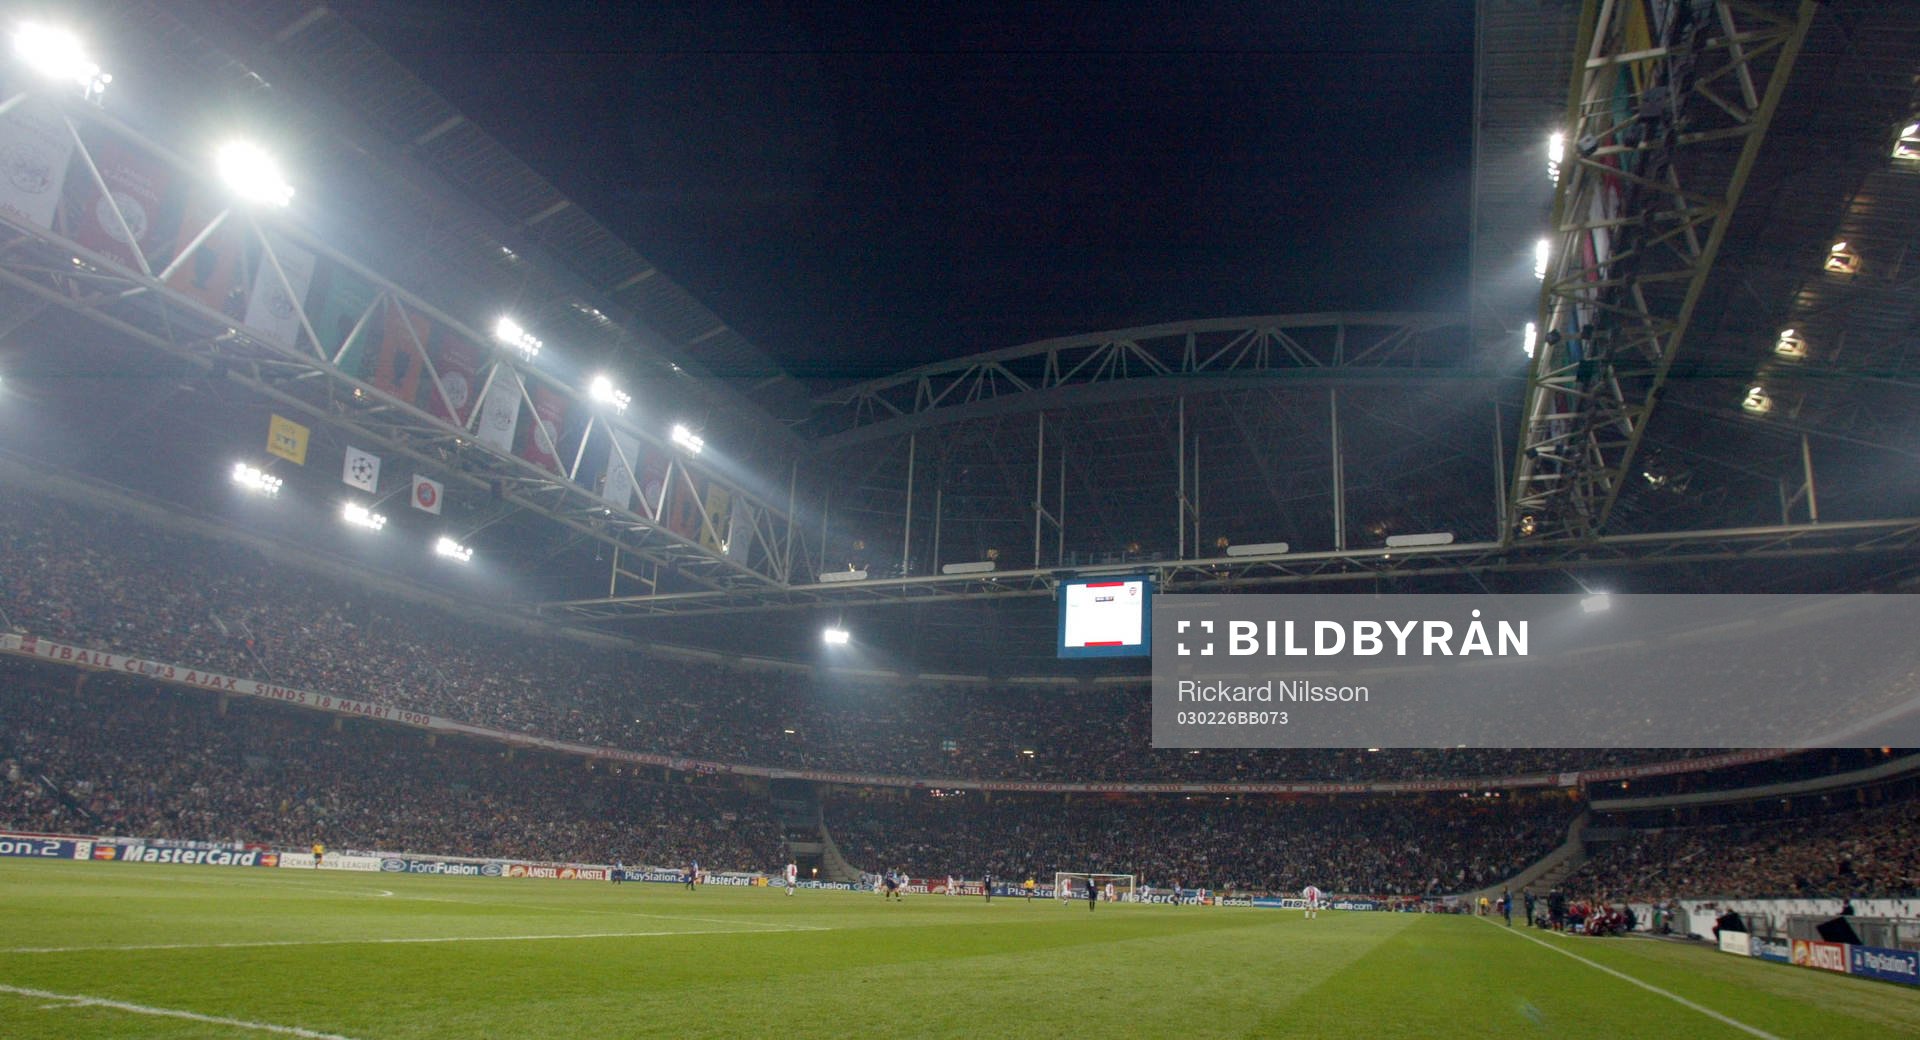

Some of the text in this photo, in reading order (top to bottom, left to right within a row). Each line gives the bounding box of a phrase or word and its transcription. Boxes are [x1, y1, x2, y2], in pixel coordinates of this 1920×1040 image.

[185, 671, 237, 690] AJAX
[254, 684, 306, 704] SINDS
[315, 695, 333, 708] 18
[338, 700, 391, 719] MAART
[397, 711, 431, 726] 1900
[122, 845, 257, 866] MasterCard
[409, 860, 478, 875] FordFusion
[527, 866, 558, 878] AMSTEL
[575, 868, 604, 880] AMSTEL
[624, 872, 677, 882] PlayStation
[704, 875, 750, 886] MasterCard
[796, 880, 850, 890] ordFusion
[1223, 898, 1250, 907] adidas
[1811, 942, 1845, 971] AMSTEL
